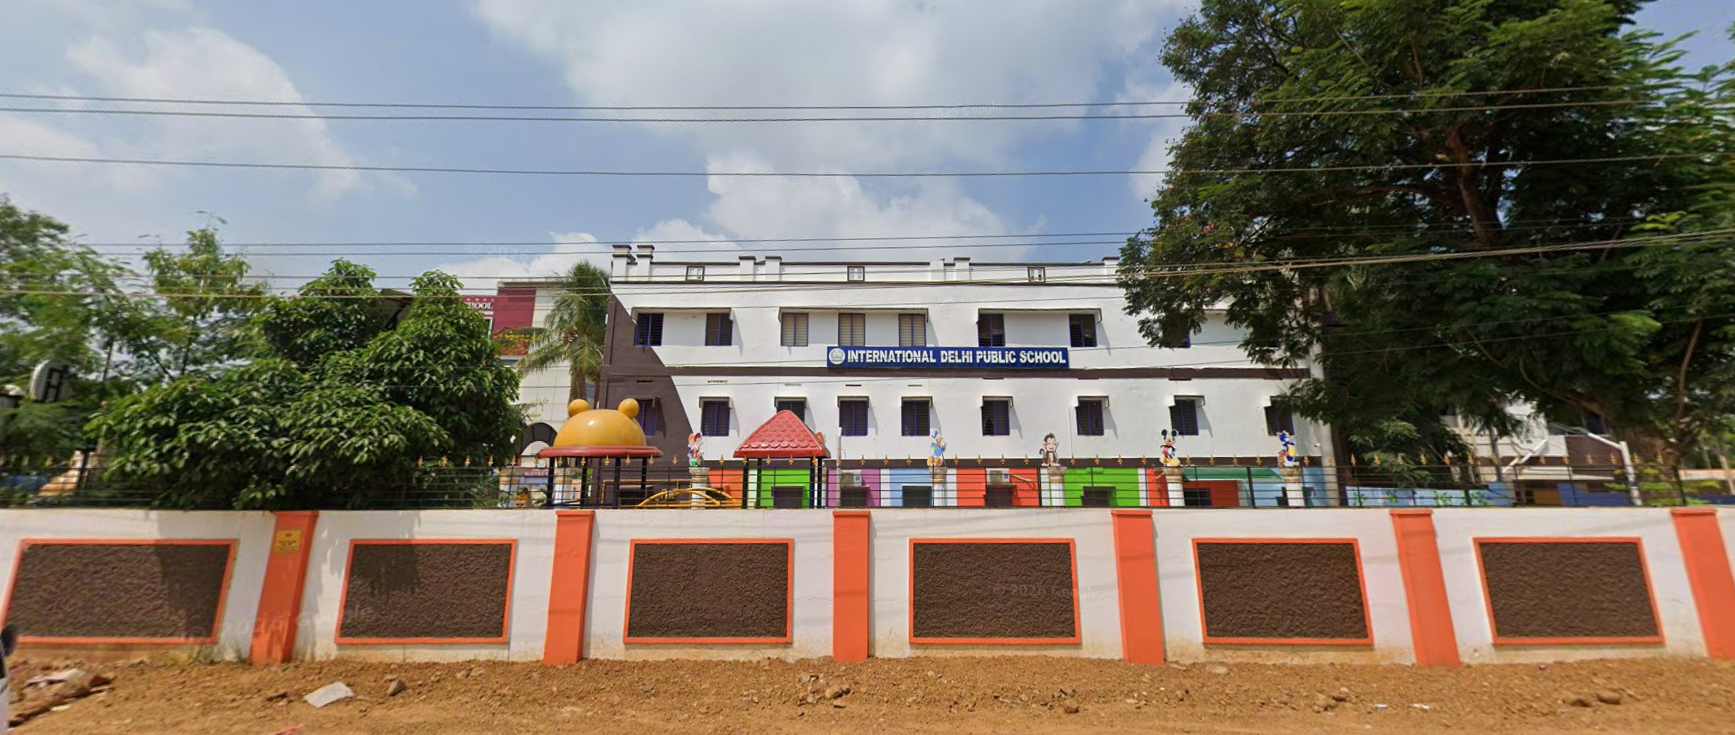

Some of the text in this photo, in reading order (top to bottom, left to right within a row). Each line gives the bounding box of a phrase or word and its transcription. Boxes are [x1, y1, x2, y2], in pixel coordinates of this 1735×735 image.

[847, 349, 937, 364] INTERNATIONAL
[940, 350, 973, 364] DELHI
[1019, 350, 1067, 364] SCHOOL
